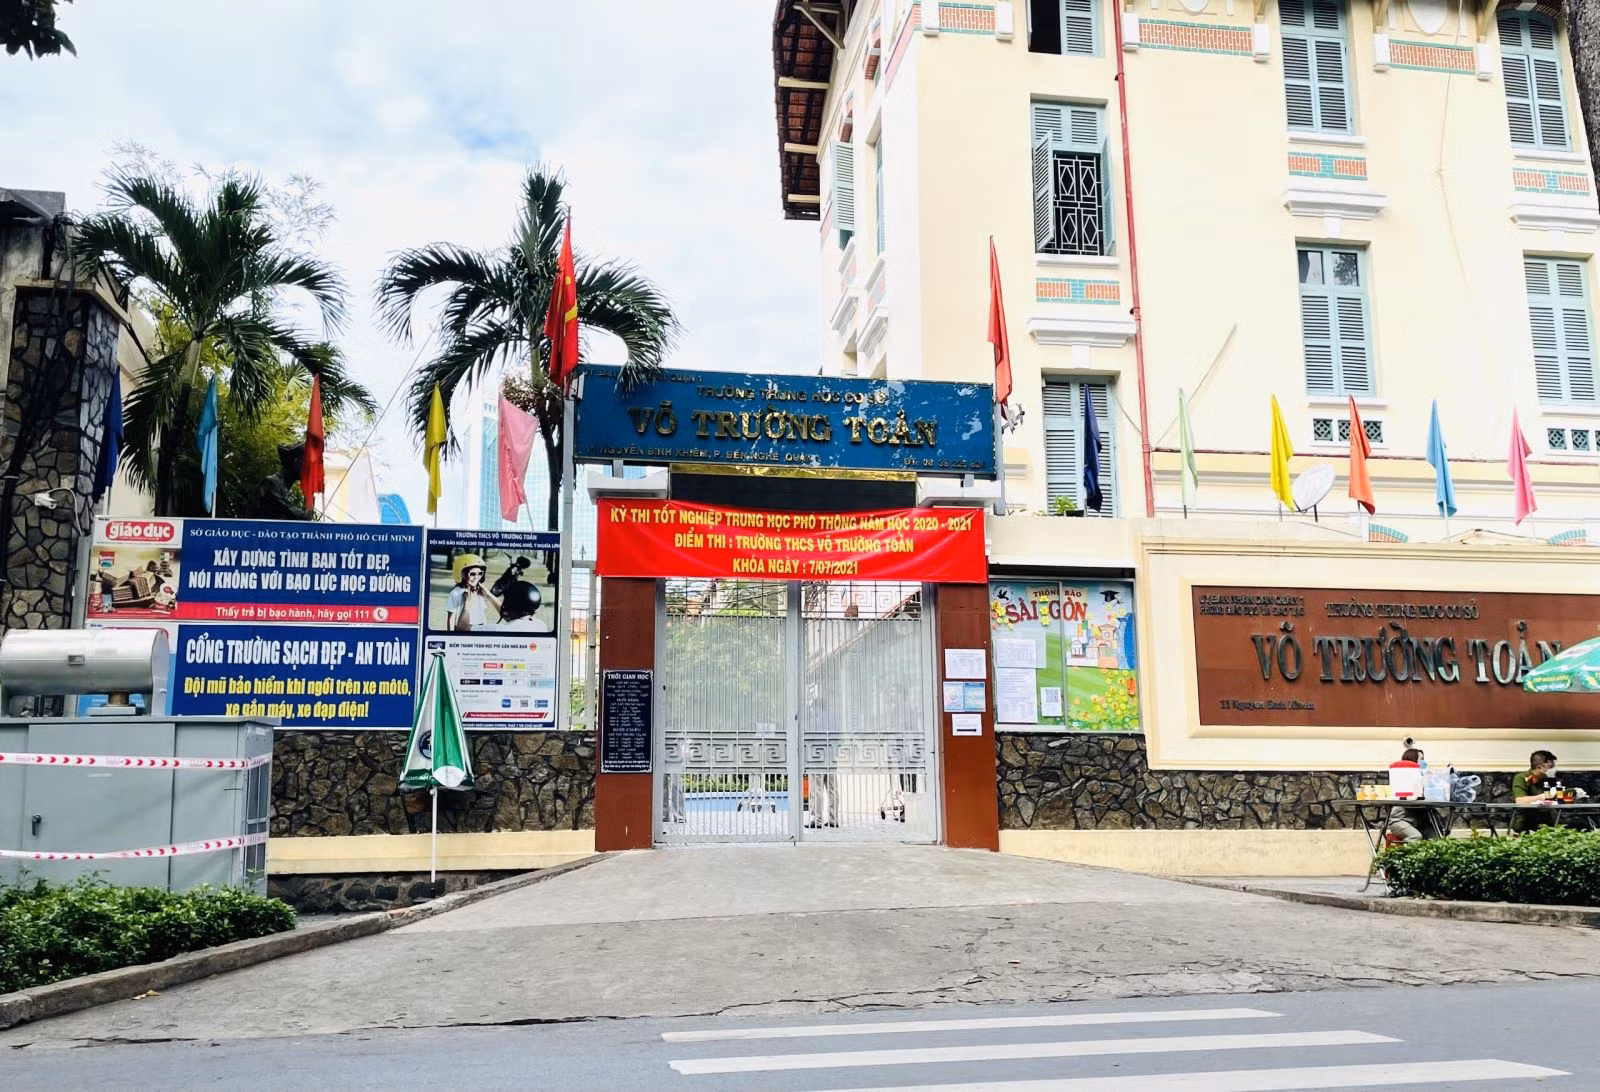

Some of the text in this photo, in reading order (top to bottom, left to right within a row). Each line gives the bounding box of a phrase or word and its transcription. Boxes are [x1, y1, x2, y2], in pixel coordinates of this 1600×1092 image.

[627, 401, 938, 446] VÕ TRƯỜNG TOẢN
[109, 522, 171, 540] giáo dục
[610, 505, 626, 522] KỲ
[630, 508, 650, 523] THI
[653, 504, 676, 523] TỐT
[679, 509, 722, 529] NGHIỆP
[725, 512, 763, 528] TRUNG
[767, 515, 791, 532] HỌC
[793, 512, 816, 529] PHỔ
[819, 514, 857, 530] THÔNG
[860, 515, 884, 531] NĂM
[887, 518, 911, 534] HỌC
[913, 517, 938, 530] 2020
[947, 517, 972, 531] 2021
[190, 527, 202, 537] SỞ
[205, 528, 229, 537] GIÁO
[231, 529, 250, 539] DỤC
[280, 531, 299, 541] TẠO
[301, 530, 333, 540] THÀNH
[372, 532, 388, 542] CHÍ
[390, 534, 415, 542] MINH
[674, 527, 704, 548] ĐIỂM
[707, 534, 726, 548] THI
[735, 534, 781, 550] TRƯỜNG
[784, 536, 814, 551] THCS
[817, 535, 832, 552] VÕ
[835, 536, 881, 552] TRƯỜNG
[884, 534, 914, 552] TOẢN
[213, 547, 390, 572] XÂY DỰNG TÌNH BẠN TỐT ĐẸP,
[732, 554, 765, 573] KHÓA
[768, 556, 799, 574] NGÀY
[809, 560, 859, 575] 7/07/2021
[189, 569, 411, 594] NÓI KHÔNG VỚI BẠO LỰC HỌC ĐƯỜNG
[1033, 589, 1082, 598] THÔN BÁO
[215, 605, 369, 621] Thấy trẻ bị bạo hành, hãy gọi 111
[1005, 596, 1088, 624] SÀI GÒN
[1325, 597, 1373, 618] TRƯỜNG
[1376, 603, 1416, 618] TRUNG
[1418, 604, 1444, 622] HỌC
[1462, 598, 1480, 619] SỞ
[186, 632, 224, 664] CỔNG
[227, 635, 280, 665] TRƯỜNG
[282, 640, 319, 670] SẠCH
[321, 641, 347, 671] ĐẸP
[355, 641, 374, 665] AN
[376, 637, 410, 665] TOÀN
[1251, 620, 1303, 682] VÕ
[1312, 621, 1461, 683] TRƯỜNG
[184, 675, 411, 698] Đội mũ bảo hiểm khi ngồi trên xe môtô,
[225, 698, 369, 721] xe gắn máy, xe đạp điện!
